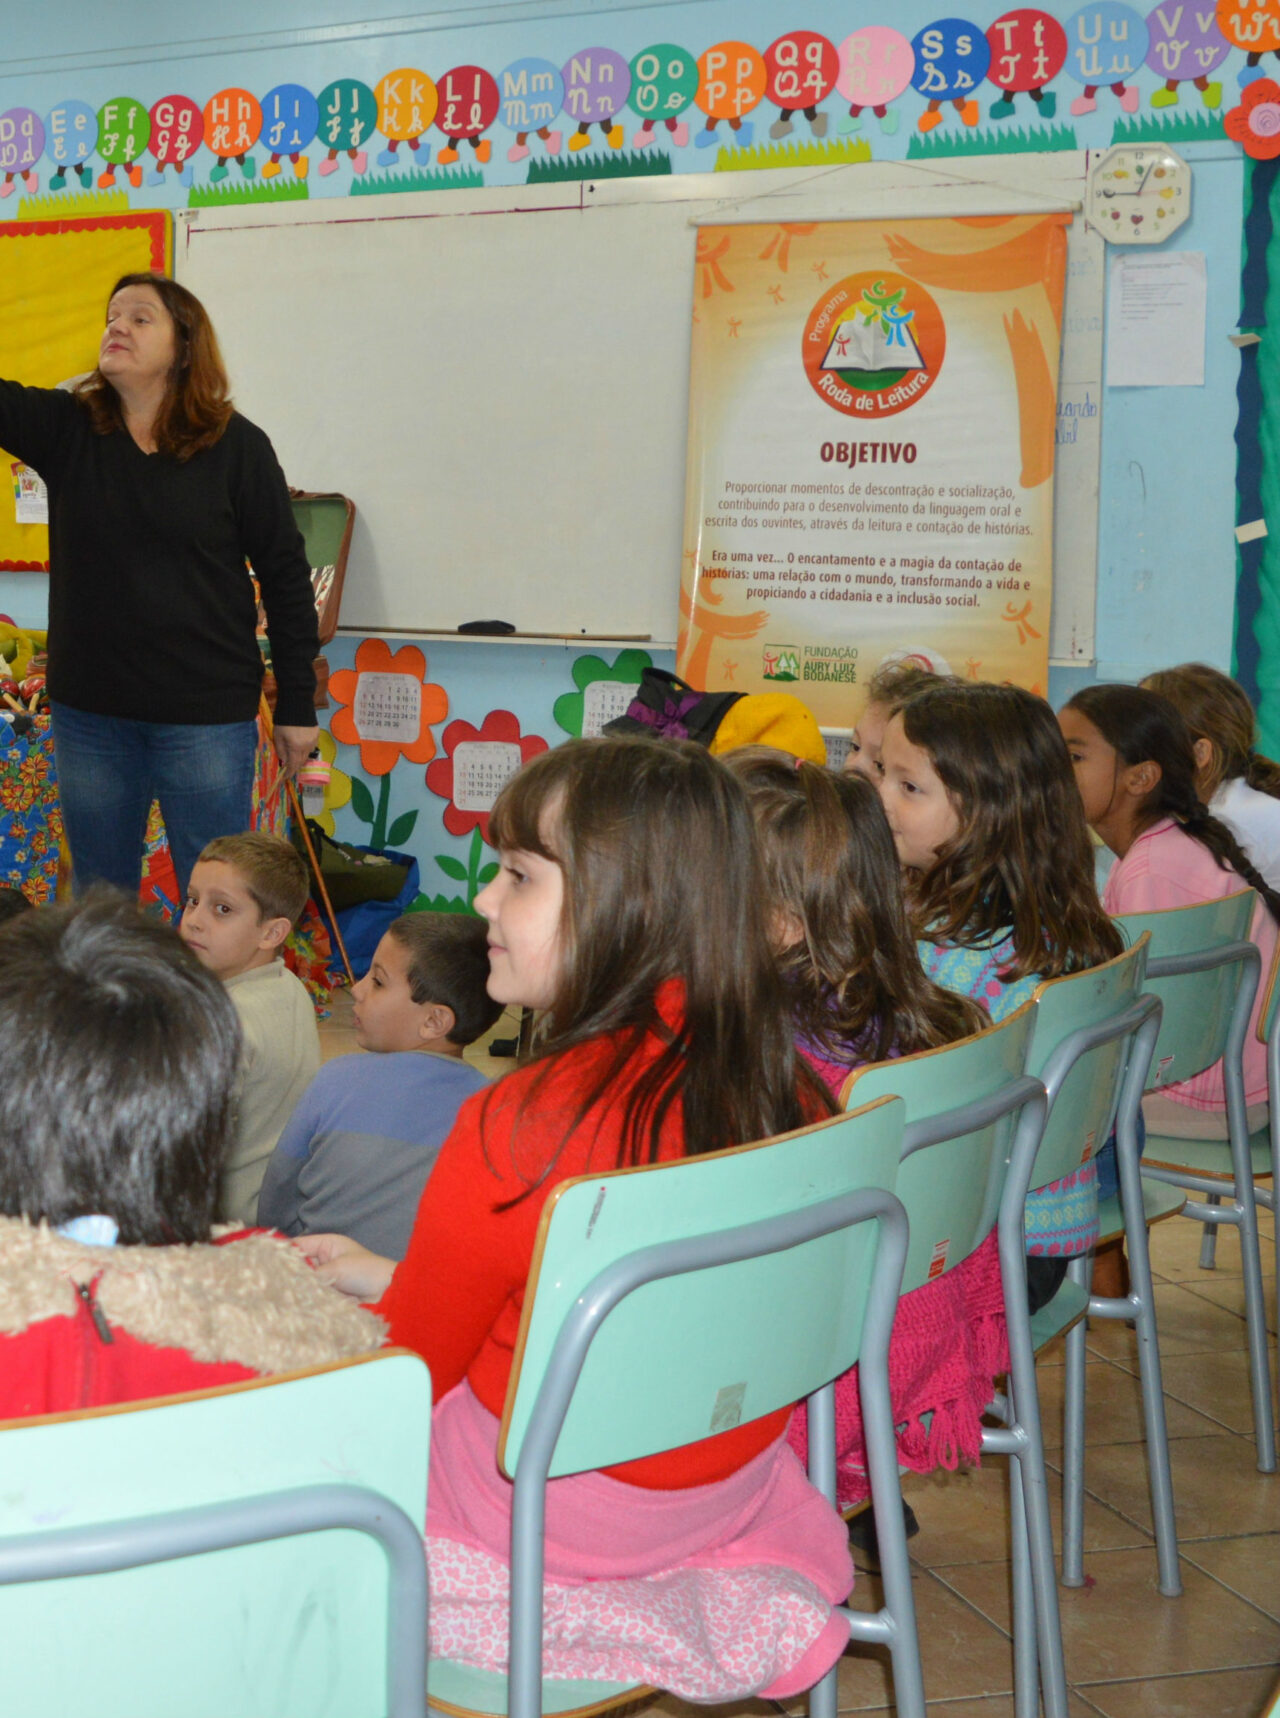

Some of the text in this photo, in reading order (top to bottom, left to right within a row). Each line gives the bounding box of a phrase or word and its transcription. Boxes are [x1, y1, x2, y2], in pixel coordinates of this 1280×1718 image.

[809, 290, 848, 341] Programa
[818, 372, 929, 410] Roda de Leitura
[820, 441, 918, 469] OBJETIVO
[791, 483, 844, 495] momentos
[848, 483, 861, 495] de
[938, 487, 945, 496] e
[783, 501, 805, 514] para
[808, 502, 815, 511] o
[912, 501, 926, 514] da
[930, 501, 985, 518] linguagem
[989, 503, 1010, 517] oral
[1014, 507, 1021, 517] e
[705, 515, 738, 527] escrita
[741, 515, 758, 528] dos
[761, 517, 806, 530] ouvintes,
[810, 517, 848, 530] através
[851, 518, 864, 530] da
[868, 519, 902, 531] leitura
[906, 521, 912, 531] e
[916, 521, 964, 535] contação
[967, 521, 981, 534] de
[712, 549, 1022, 573] Era uma vez... O encantamento e a magia da contação de
[702, 566, 1031, 590] histórias: uma relação com o mundo, transformando a vida e
[746, 586, 980, 607] propiciando a cidadania e a inclusão social.
[804, 645, 858, 660] FUNDAÇÃO
[803, 661, 856, 673] AURY LUIZ
[803, 670, 856, 683] BODANESE
